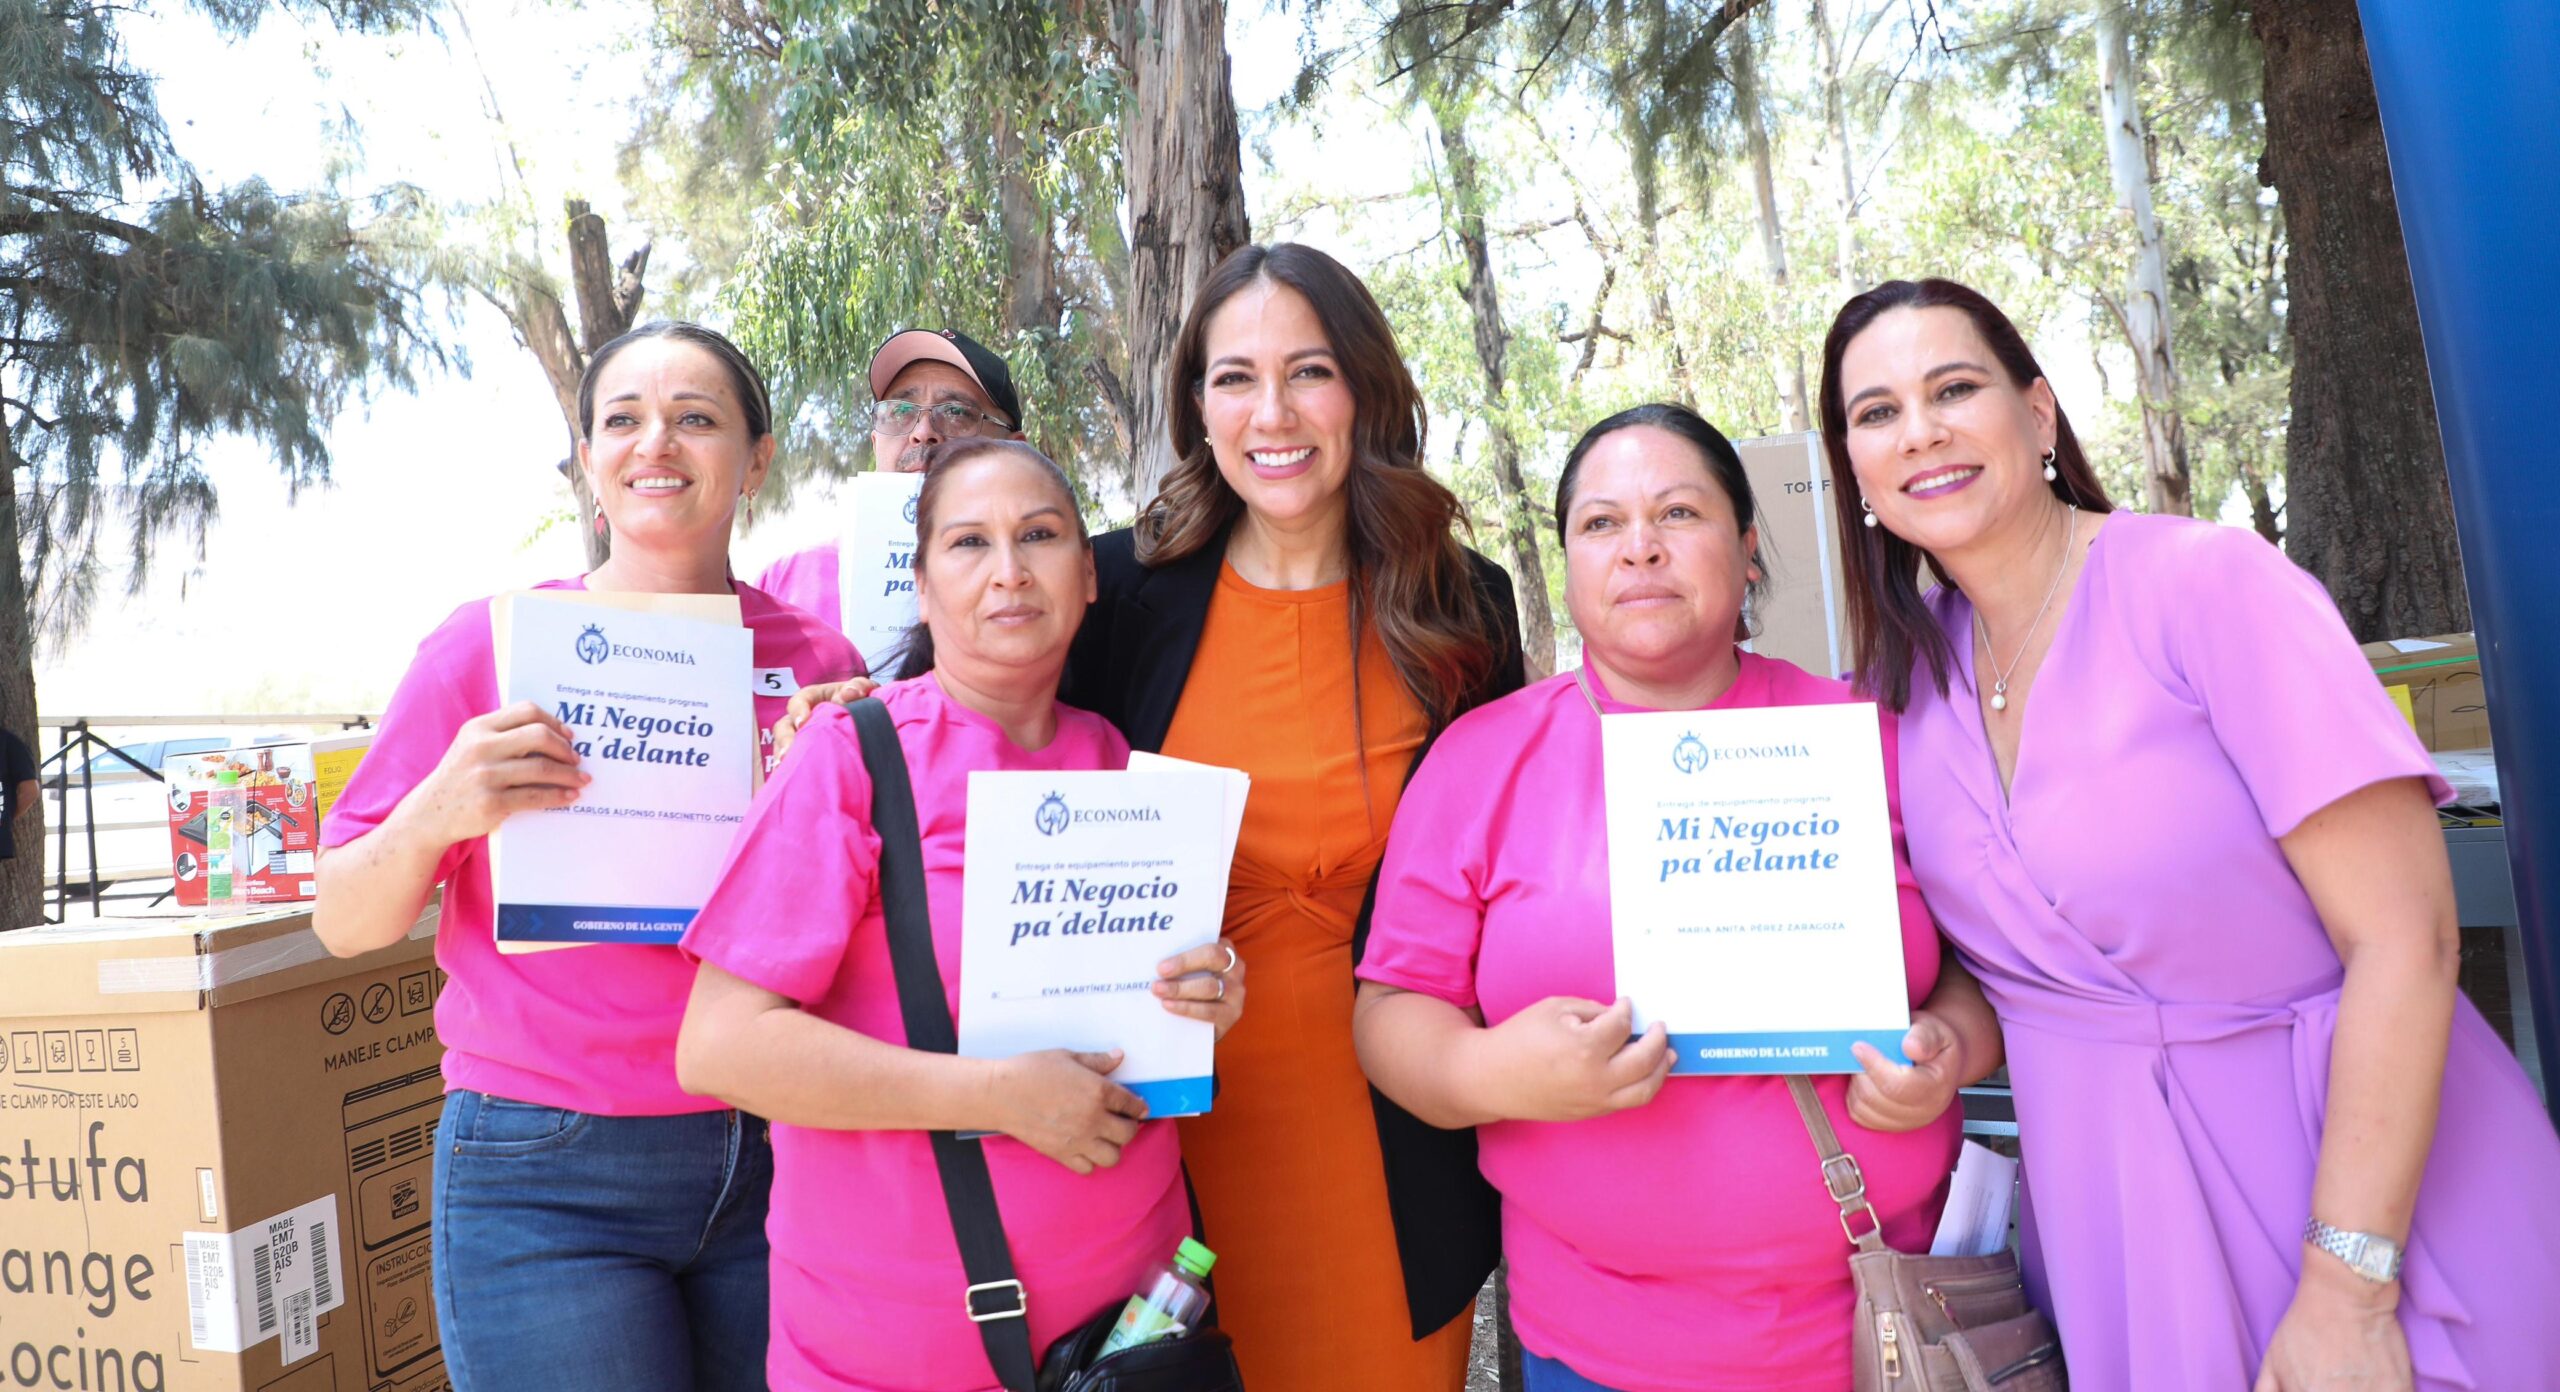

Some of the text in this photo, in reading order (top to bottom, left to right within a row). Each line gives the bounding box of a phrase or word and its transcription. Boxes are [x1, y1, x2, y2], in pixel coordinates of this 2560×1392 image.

[613, 644, 696, 665] ECONOMÍA
[765, 673, 782, 689] 5
[556, 684, 709, 708] Entrega de equipamiento programa
[556, 701, 713, 738] Mi Negocio
[573, 735, 710, 767] a´delante
[1713, 743, 1811, 760] ECONOMÍA
[1657, 801, 1694, 809] Entrega
[1713, 797, 1780, 808] equipamiento
[1783, 795, 1831, 805] programa
[573, 806, 610, 815] CARLOS
[613, 808, 656, 818] ALFONSO
[658, 811, 712, 820] FASCINETTO
[1074, 806, 1161, 822] ECONOMÍA
[1657, 813, 1840, 846] Mi Negocio
[1015, 859, 1173, 871] Entrega de equipamiento programa
[1011, 876, 1178, 908] Mi Negocio
[573, 921, 685, 931] GOBIERNO DE LA GENTE
[1715, 925, 1746, 933] ANITA
[1751, 923, 1783, 932] PÉREZ
[1787, 922, 1846, 931] ZARAGOZA
[1042, 988, 1060, 996] EVA
[1064, 984, 1112, 994] MARTÍNEZ
[324, 1026, 434, 1073] MANEJE CLAMP
[1700, 1046, 1829, 1059] GOBIERNO DE LA GENTE
[10, 1094, 48, 1109] CLAMP
[52, 1093, 76, 1109] POR
[80, 1093, 104, 1108] ESTE
[107, 1093, 139, 1108] LADO
[0, 1121, 148, 1202] stufa
[269, 1216, 295, 1234] MABE
[199, 1240, 219, 1250] MABE
[272, 1228, 295, 1247] EM7
[202, 1252, 220, 1263] EM7
[273, 1241, 299, 1260] 620B
[203, 1265, 224, 1277] 620B
[274, 1255, 292, 1272] AIS
[2, 1249, 155, 1318] ange
[204, 1278, 219, 1289] AIS
[275, 1272, 282, 1284] 2
[205, 1289, 211, 1300] 2
[0, 1322, 165, 1392] ocina
